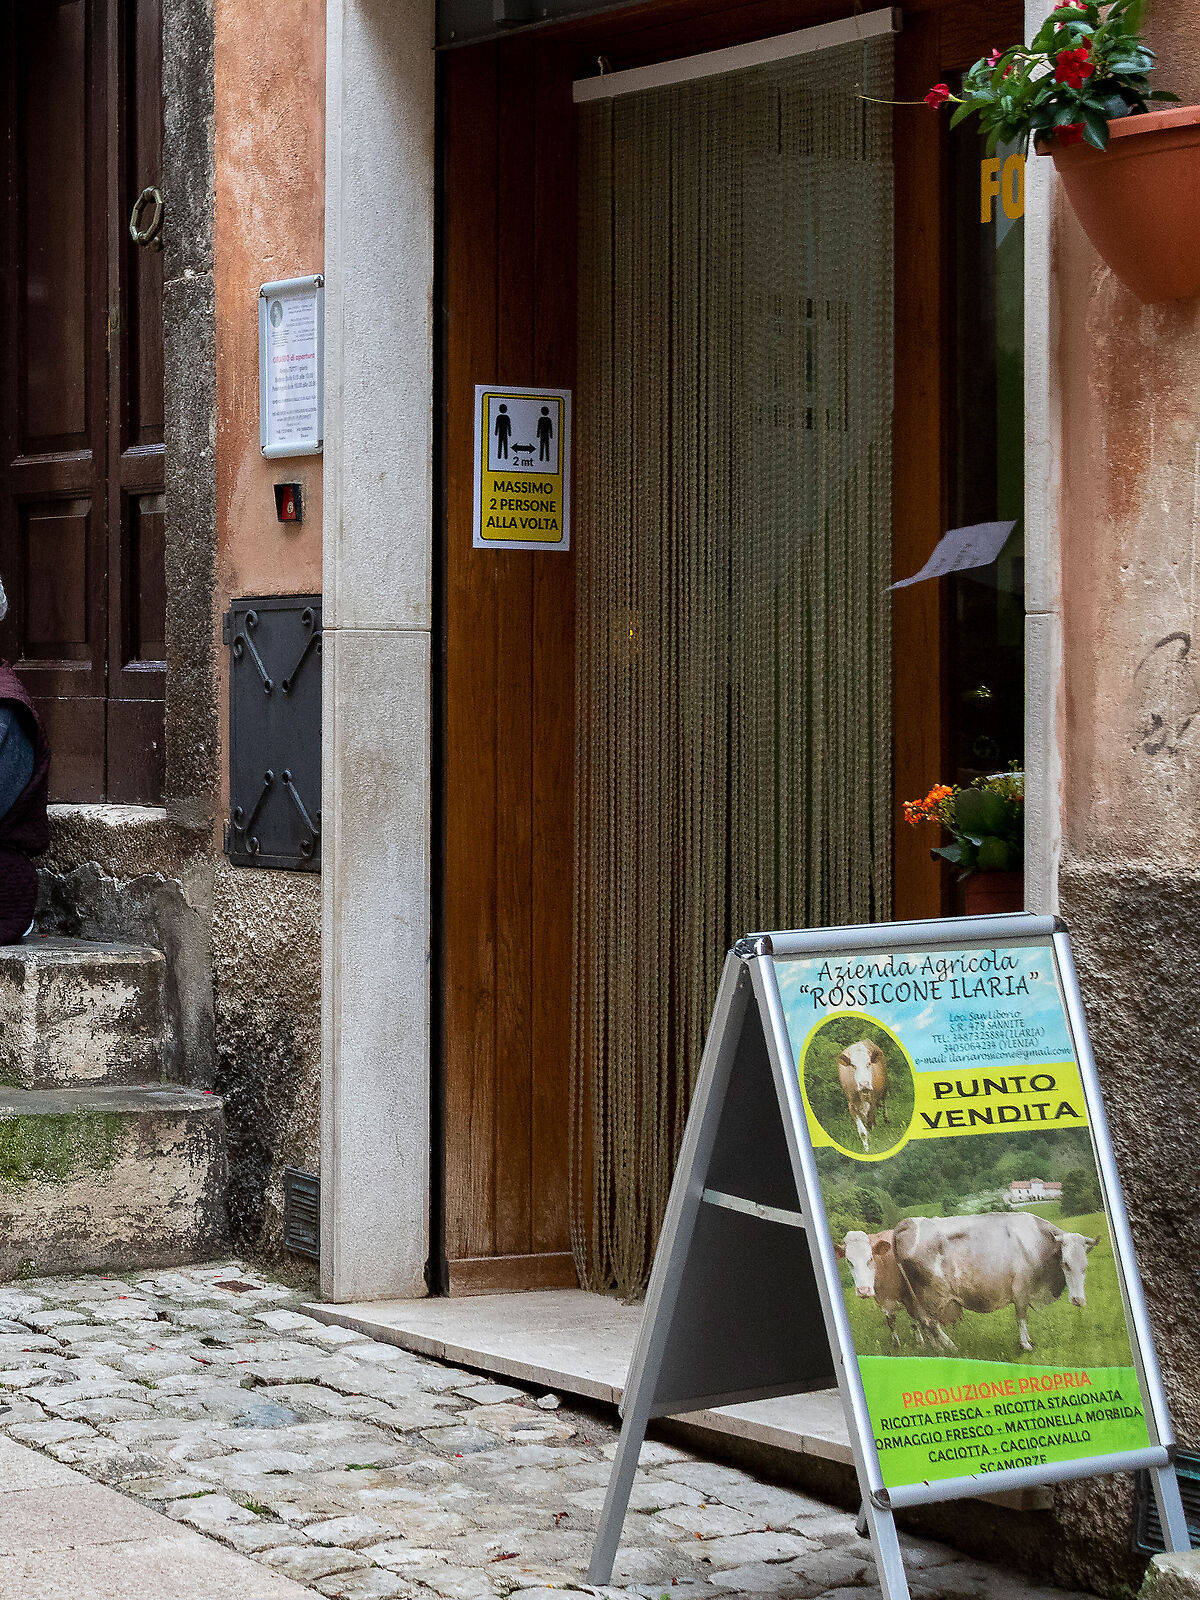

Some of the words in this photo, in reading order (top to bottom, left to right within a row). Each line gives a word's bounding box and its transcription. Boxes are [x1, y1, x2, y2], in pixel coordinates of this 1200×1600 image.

[512, 456, 519, 466] 2
[521, 457, 534, 467] mt
[493, 480, 553, 495] MASSIMO
[489, 498, 497, 510] 2
[500, 499, 556, 513] PERSONE
[486, 515, 517, 528] ALLA
[519, 517, 559, 531] VOLTA
[817, 955, 917, 988] Azienda
[920, 949, 1019, 982] Agricola
[969, 1011, 987, 1021] San
[988, 1009, 1022, 1020] Liborio
[969, 1021, 985, 1031] 479
[987, 1018, 1025, 1030] SANNITE
[931, 1034, 950, 1044] TEL:
[999, 1036, 1039, 1050] (YLENIA)
[915, 1053, 947, 1065] e-mail:
[933, 1074, 1058, 1100] PUNTO
[920, 1101, 1082, 1129] VENDITA
[902, 1379, 1017, 1409] PRODUZIONE
[1018, 1371, 1094, 1394] PROPRIA
[880, 1413, 934, 1431] RICOTTA
[935, 1406, 984, 1424] FRESCA
[994, 1399, 1046, 1416] RICOTTA
[1047, 1389, 1123, 1409] STAGIONATA
[875, 1431, 943, 1451] ORMAGGIO
[945, 1424, 994, 1441] FRESCO
[1005, 1412, 1084, 1434] MATTONELLA
[1085, 1406, 1144, 1424] MORBIDA
[928, 1444, 991, 1463] CACIOTTA
[1000, 1430, 1091, 1453] CACIOCAVALLO
[979, 1454, 1048, 1474] SCAMORZE
